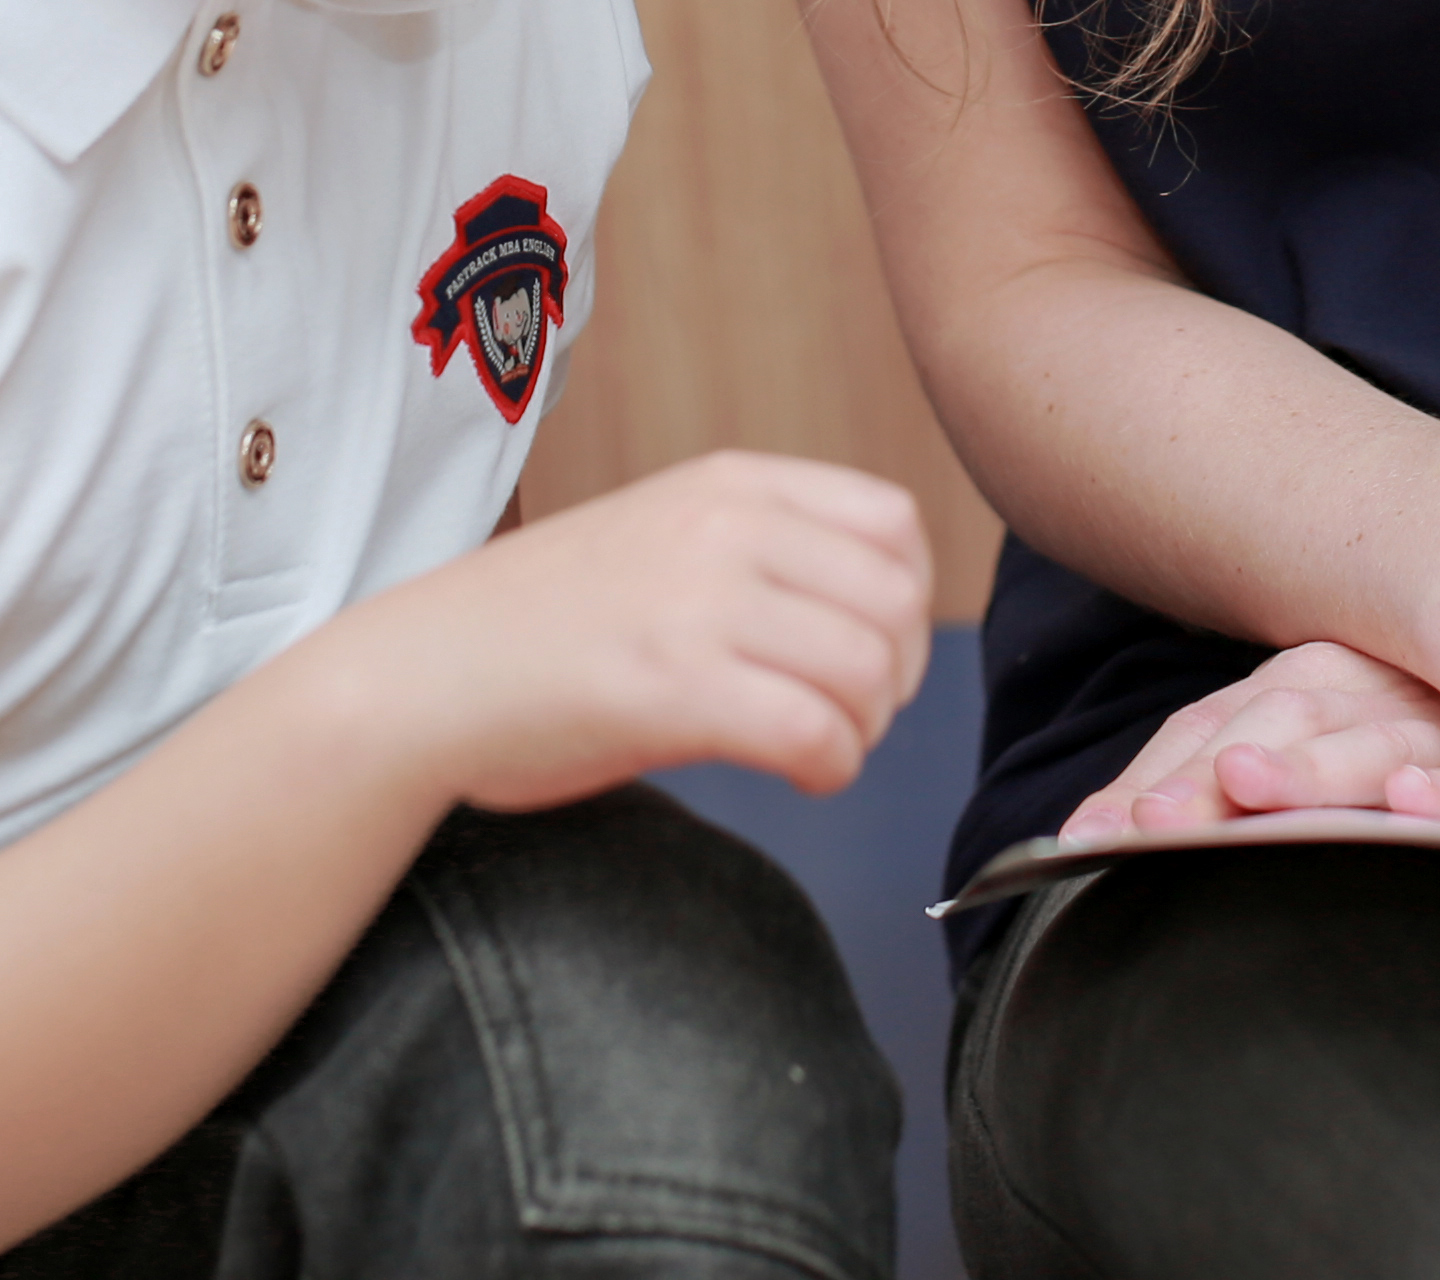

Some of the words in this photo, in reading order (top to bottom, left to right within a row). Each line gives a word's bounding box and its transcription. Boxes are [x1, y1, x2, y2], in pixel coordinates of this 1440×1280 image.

[445, 246, 498, 300] FASTRACK
[498, 239, 521, 258] MBA
[522, 237, 556, 262] ENGLISH
